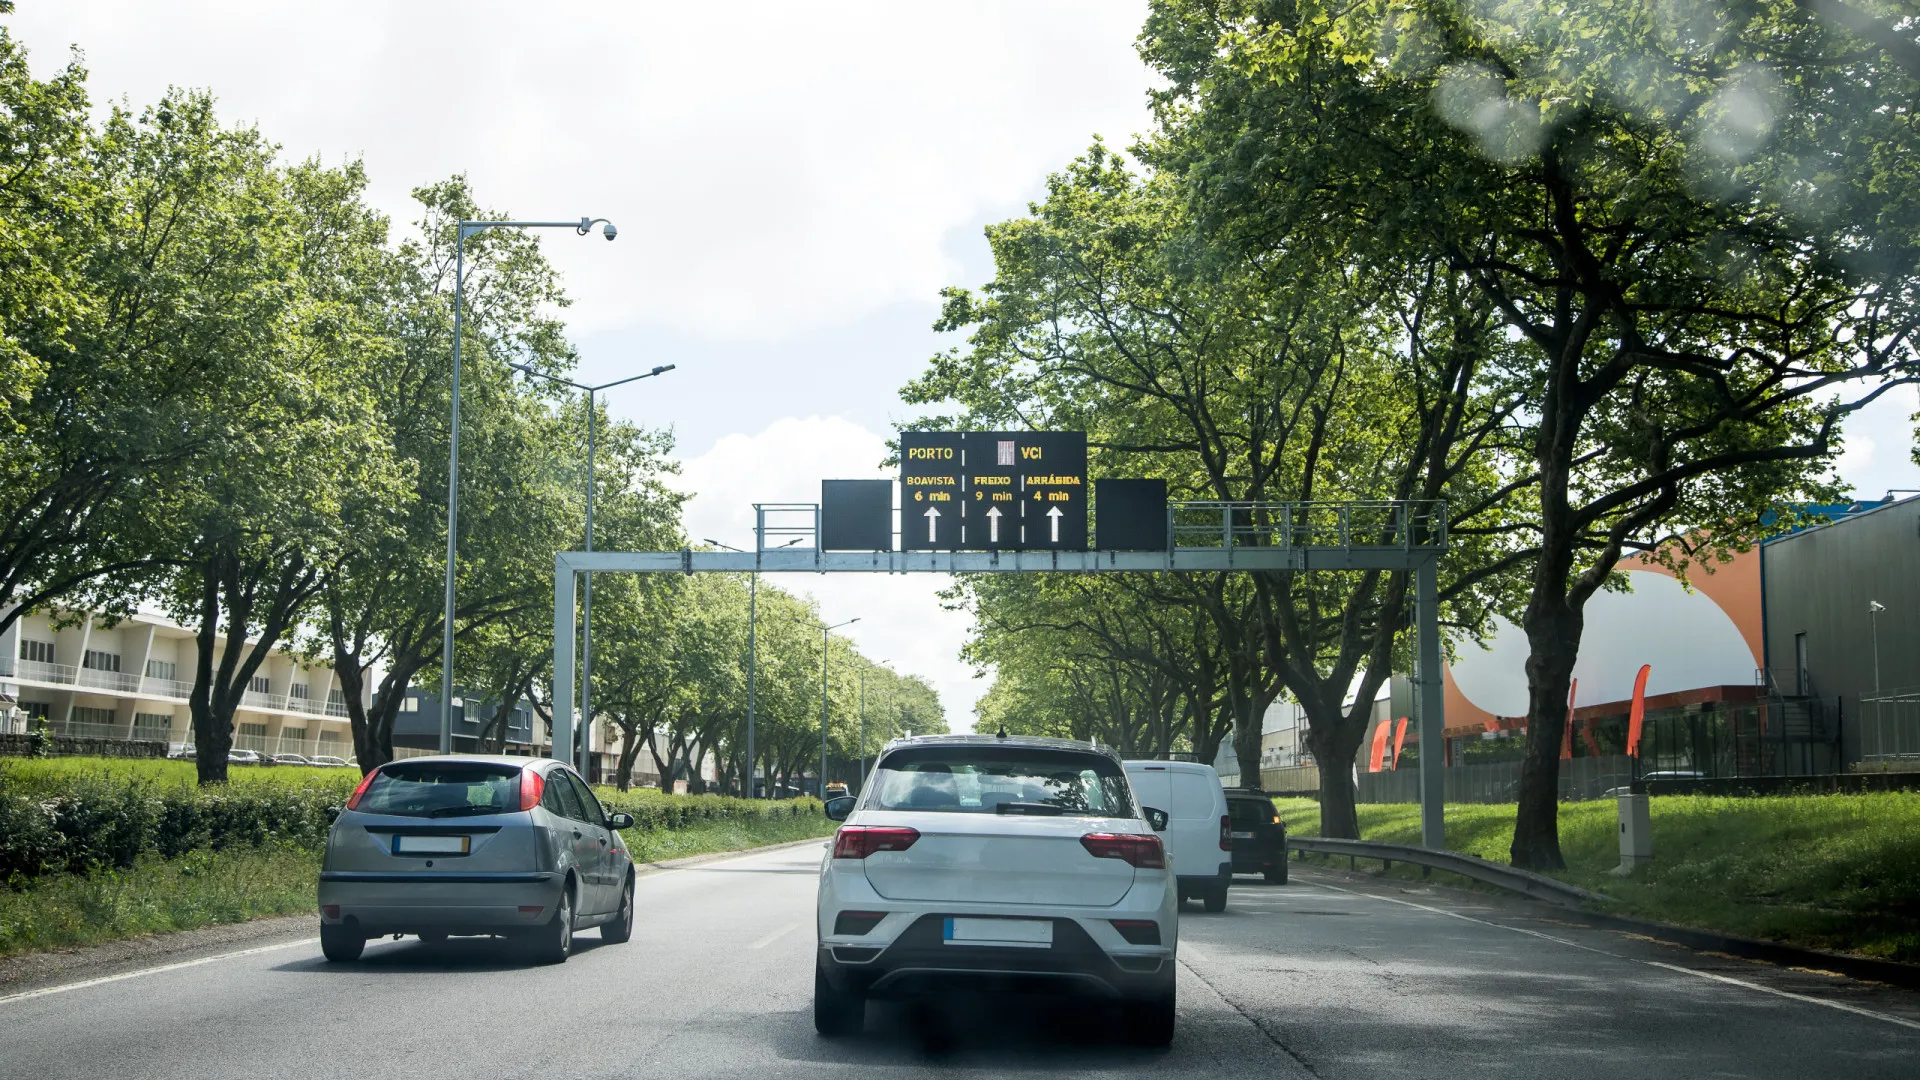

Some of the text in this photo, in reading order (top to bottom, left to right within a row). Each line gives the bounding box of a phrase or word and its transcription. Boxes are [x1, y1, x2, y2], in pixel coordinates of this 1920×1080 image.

[908, 447, 954, 460] PORTO
[1021, 446, 1042, 460] VCI
[906, 476, 956, 485] BOAVISTA
[974, 476, 1011, 485] FREIXO
[1026, 473, 1081, 485] ARRÁBIDA
[914, 490, 951, 501] 6 min
[975, 490, 1013, 501] 9 min
[1033, 490, 1069, 501] 4 min
